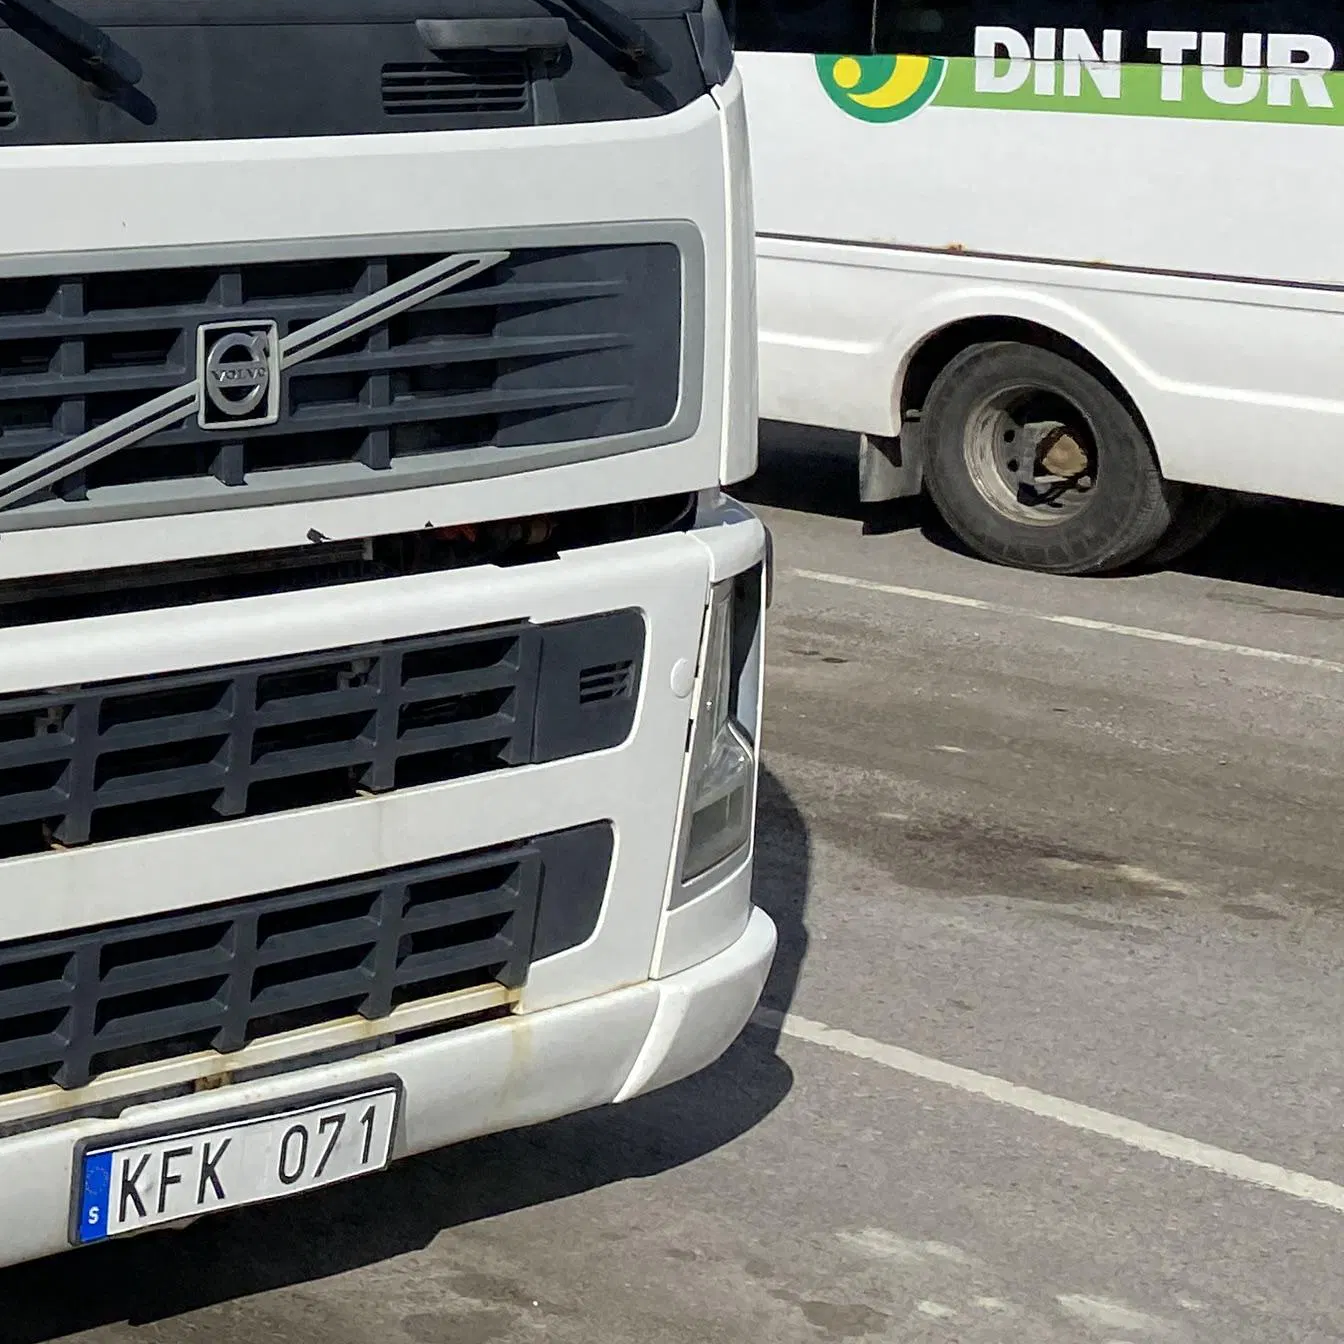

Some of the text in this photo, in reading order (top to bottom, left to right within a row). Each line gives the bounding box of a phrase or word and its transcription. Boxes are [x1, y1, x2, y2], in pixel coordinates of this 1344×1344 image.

[974, 25, 1335, 109] DIN TUR
[212, 366, 266, 383] VOLVO
[118, 1104, 378, 1223] KFK 071
[88, 1206, 99, 1225] S
